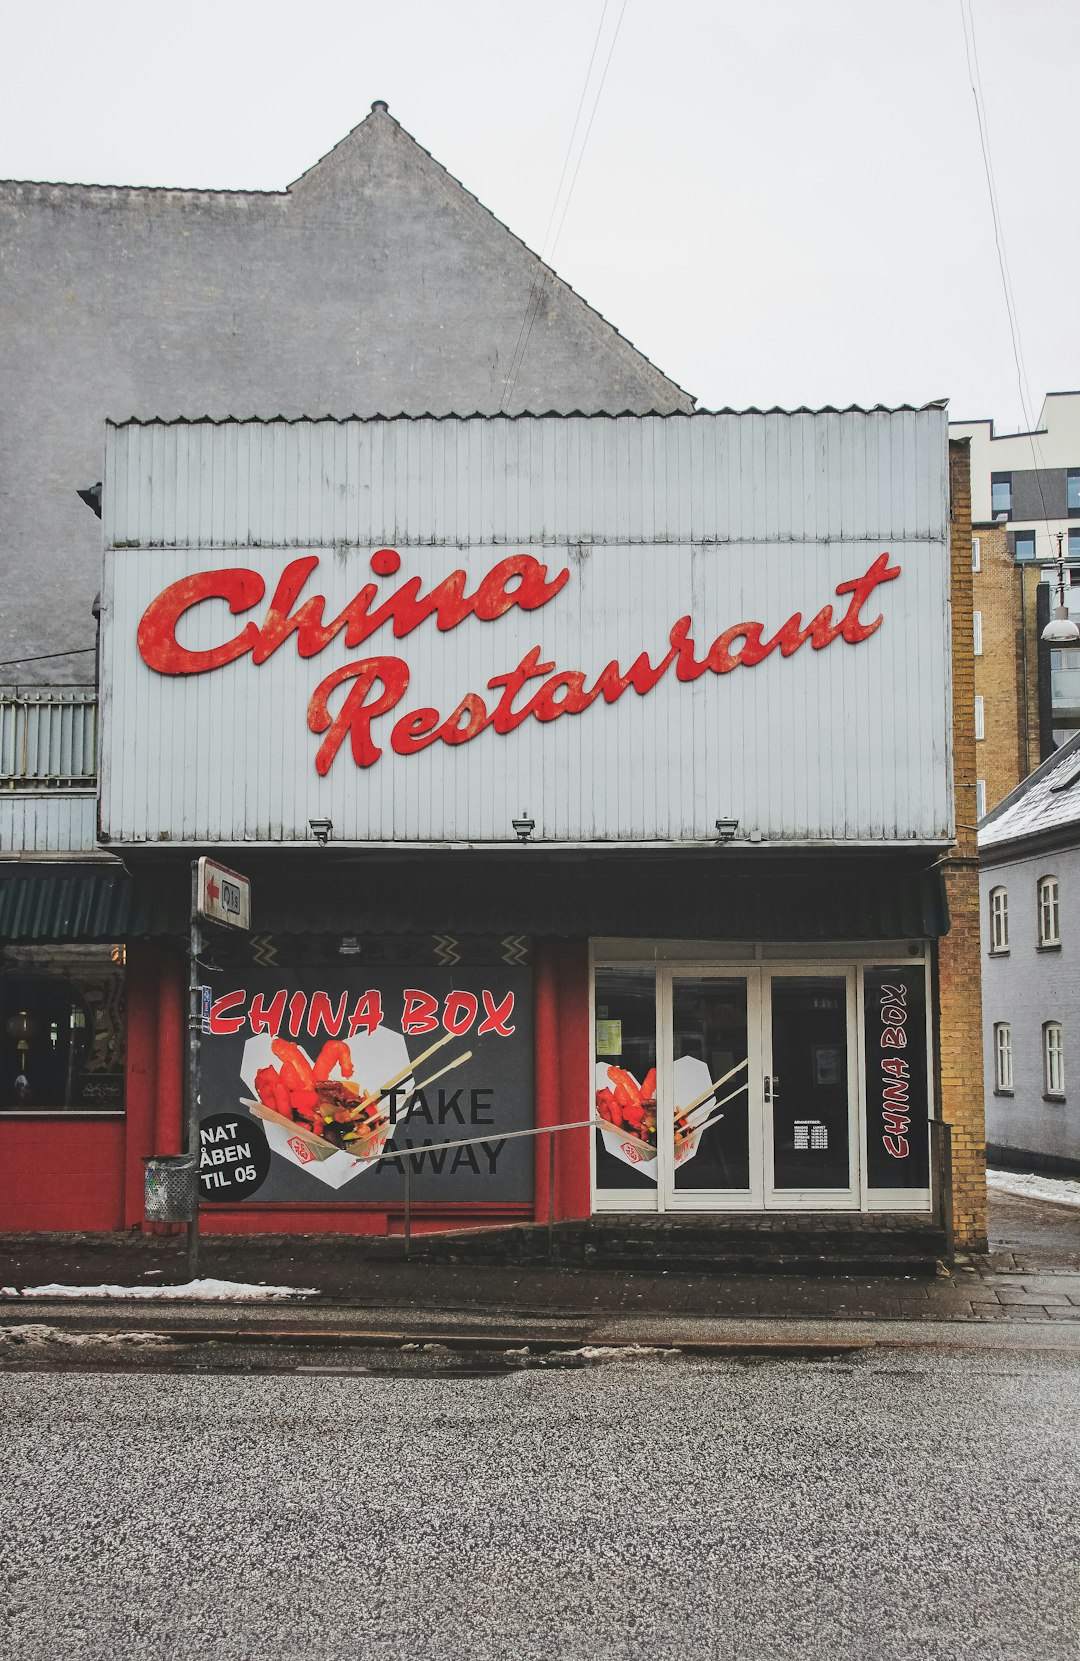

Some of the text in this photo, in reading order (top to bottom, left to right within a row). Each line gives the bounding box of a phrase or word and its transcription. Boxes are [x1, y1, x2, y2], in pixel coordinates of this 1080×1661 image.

[137, 549, 570, 677] China
[307, 552, 901, 777] Restaurant
[209, 989, 384, 1039] CHINA
[401, 989, 516, 1037] BOX
[880, 983, 911, 1159] CHINA BOX
[380, 1088, 495, 1125] TAKE
[200, 1122, 238, 1145] NAT
[200, 1142, 252, 1168] ÅBEN
[375, 1138, 507, 1175] AWAY
[200, 1164, 257, 1190] TIL 05
